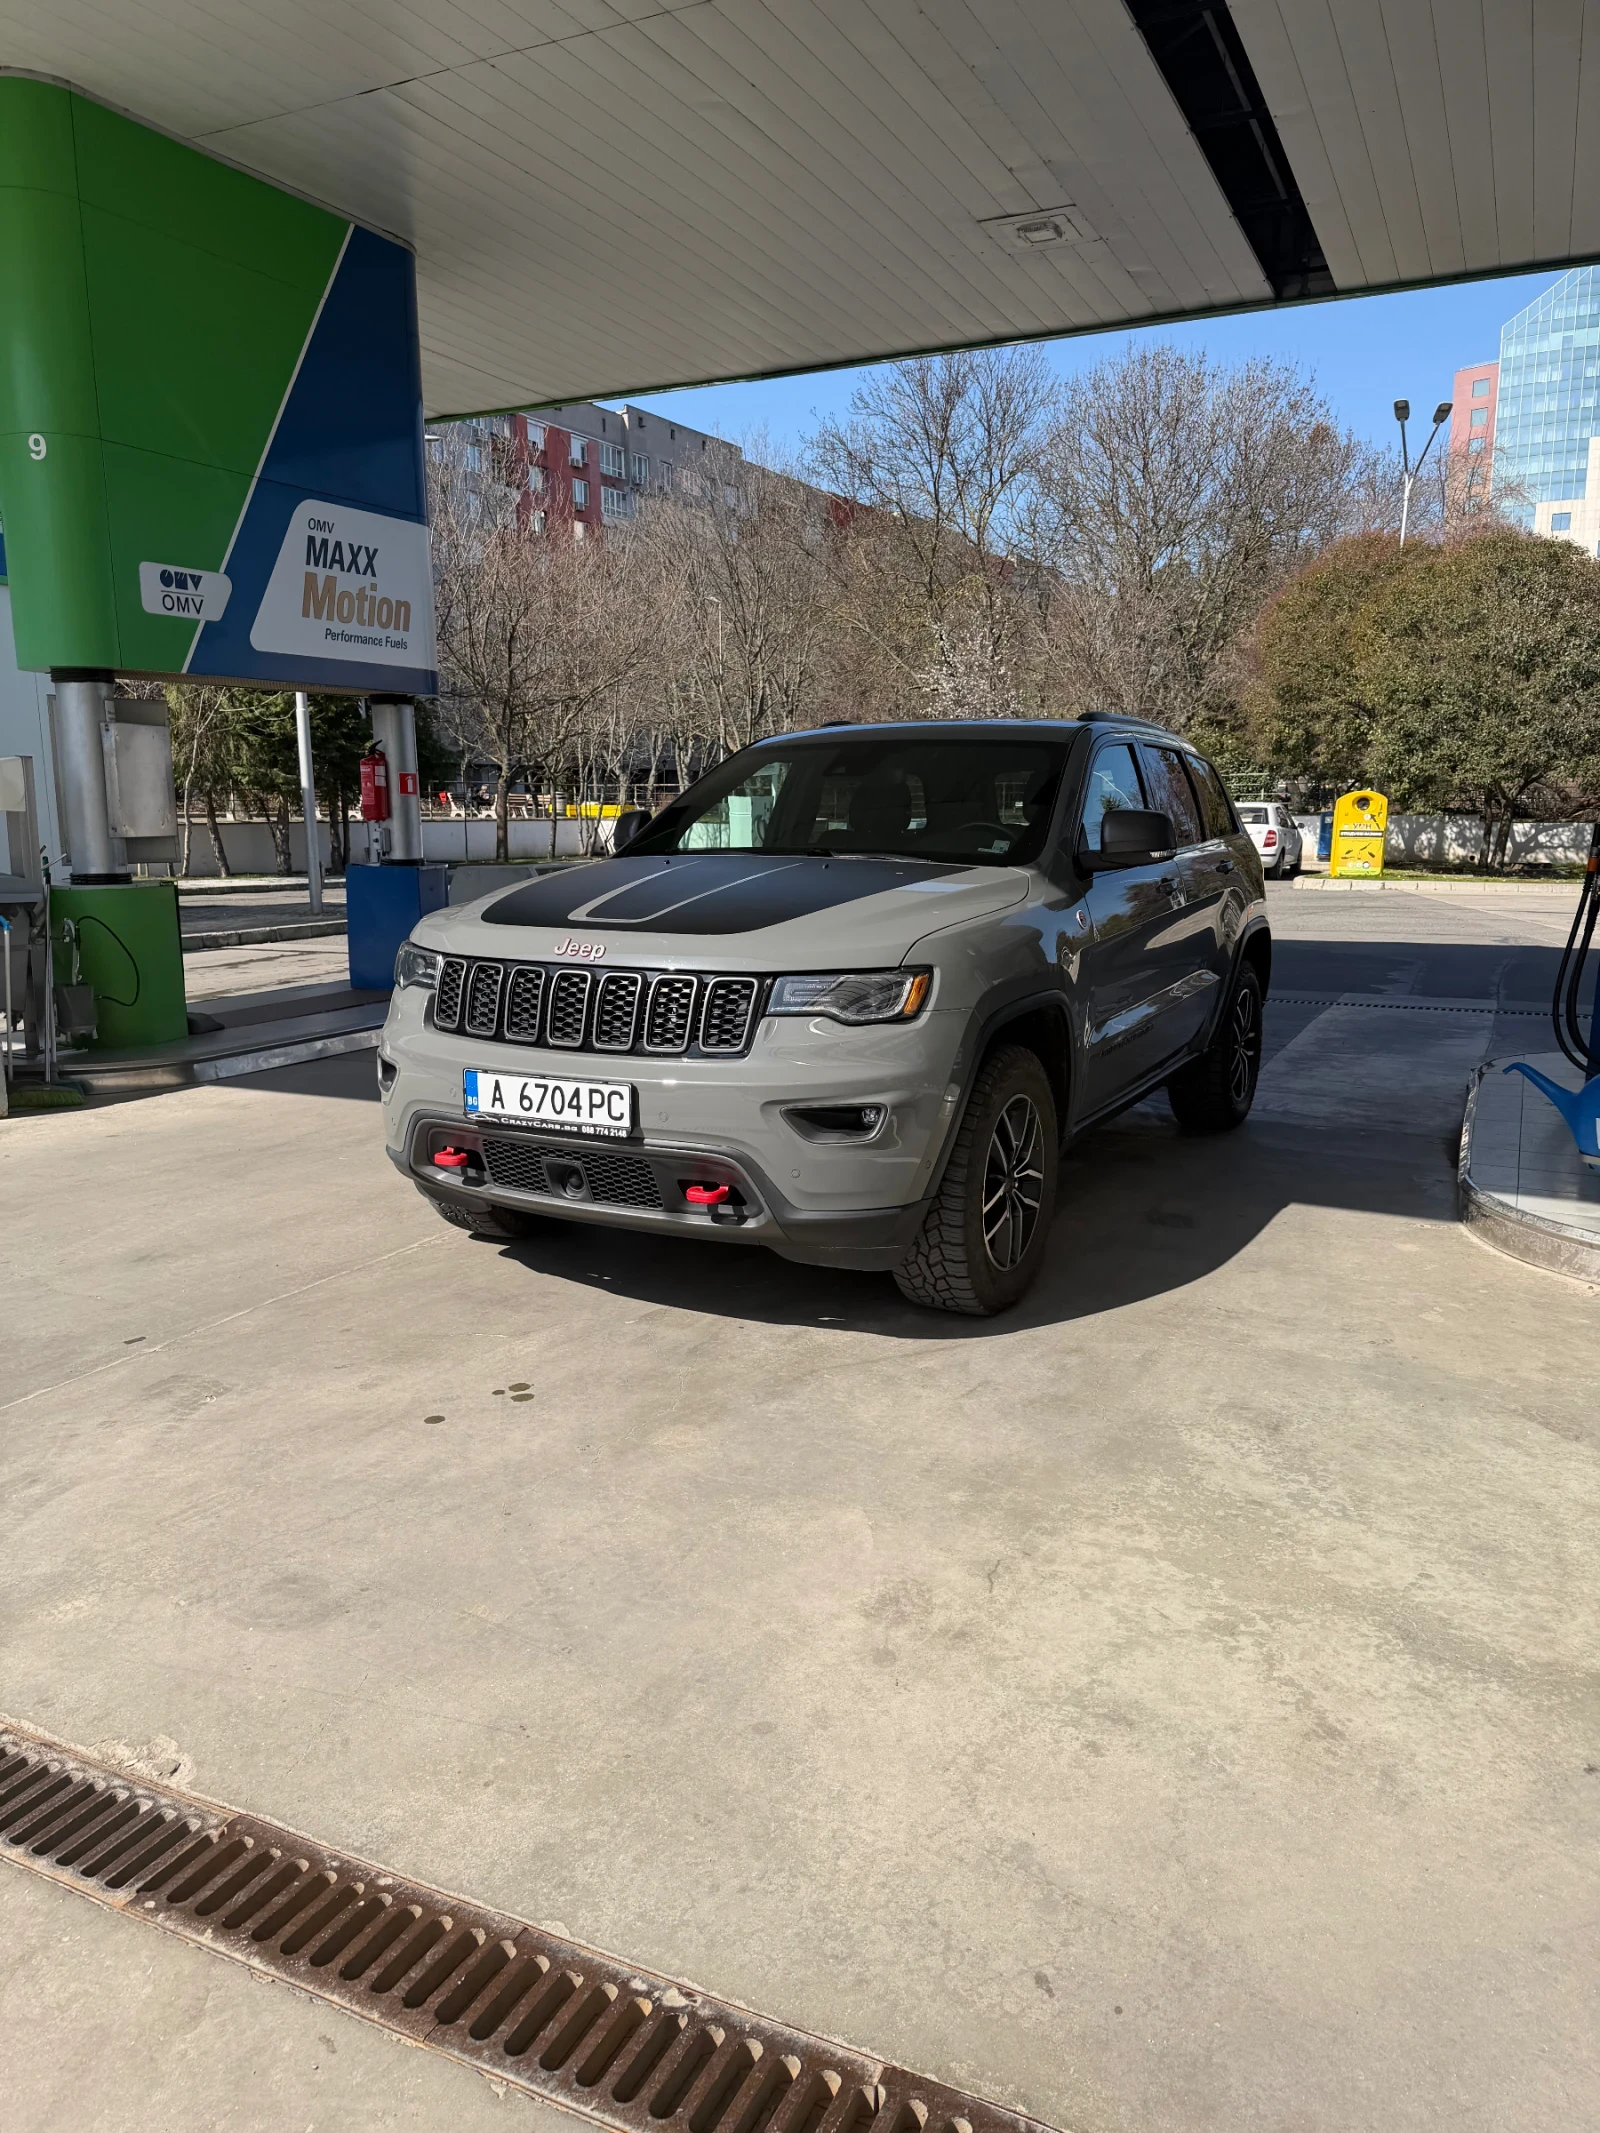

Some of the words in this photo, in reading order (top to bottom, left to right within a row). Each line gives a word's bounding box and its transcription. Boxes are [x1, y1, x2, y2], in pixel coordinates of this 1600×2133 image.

[28, 433, 47, 461] 9
[307, 517, 335, 534] OMV
[305, 534, 379, 578] MAXX
[162, 593, 204, 615] OMV
[301, 571, 412, 633] Motion
[324, 627, 383, 647] Performance
[385, 635, 408, 650] Fuels
[554, 937, 607, 962] Jeep
[467, 1095, 478, 1106] BG
[491, 1079, 505, 1109] A
[595, 1127, 609, 1136] 774
